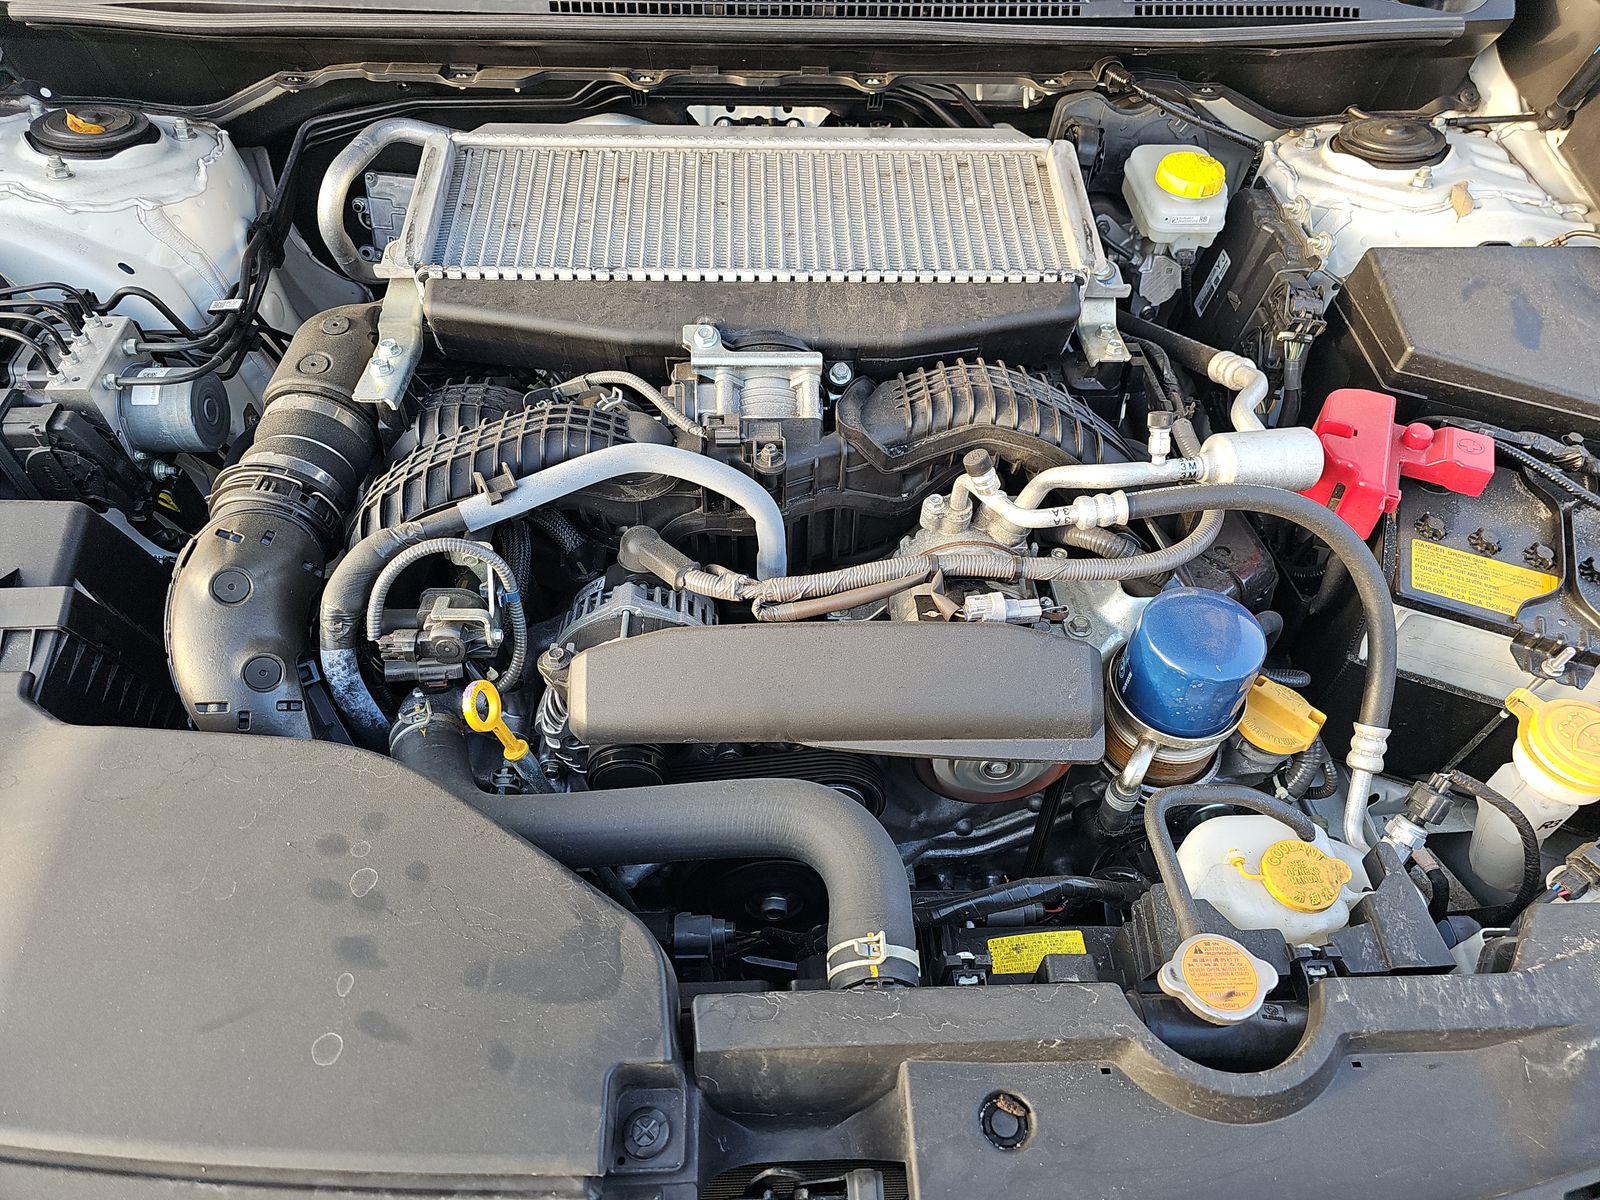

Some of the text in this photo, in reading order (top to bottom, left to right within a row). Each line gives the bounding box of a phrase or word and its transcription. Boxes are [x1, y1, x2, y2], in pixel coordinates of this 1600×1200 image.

[1415, 541, 1445, 554] DANGER
[1415, 563, 1445, 576] POISON
[1451, 592, 1466, 601] CCA
[1267, 842, 1327, 866] COOLANT
